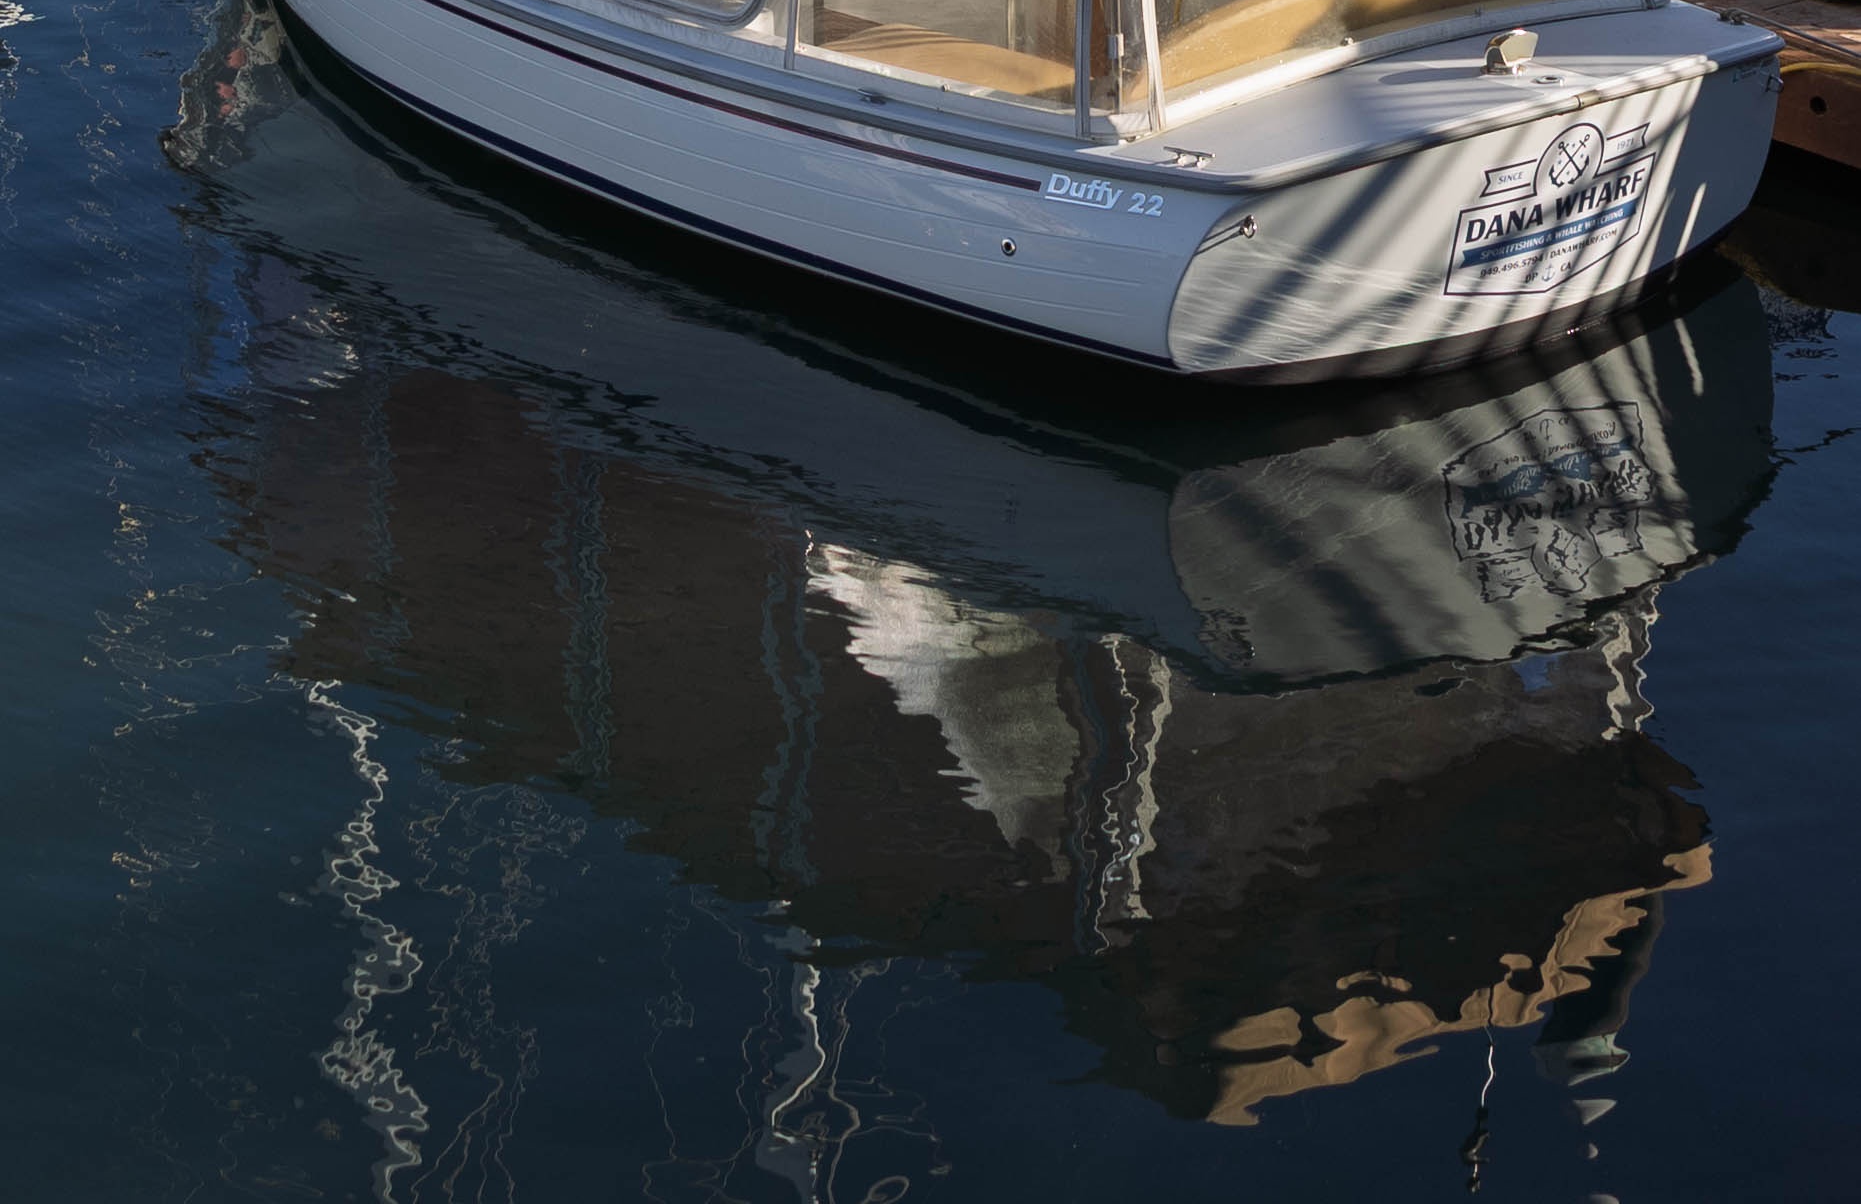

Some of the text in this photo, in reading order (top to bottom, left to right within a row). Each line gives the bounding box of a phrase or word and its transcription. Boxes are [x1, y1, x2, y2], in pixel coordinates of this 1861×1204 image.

[1498, 171, 1524, 185] SINCE
[1046, 173, 1165, 217] Duffy 22
[1465, 168, 1646, 244] DANA WHARF
[1555, 222, 1583, 240] WHALE
[1560, 261, 1572, 273] CA
